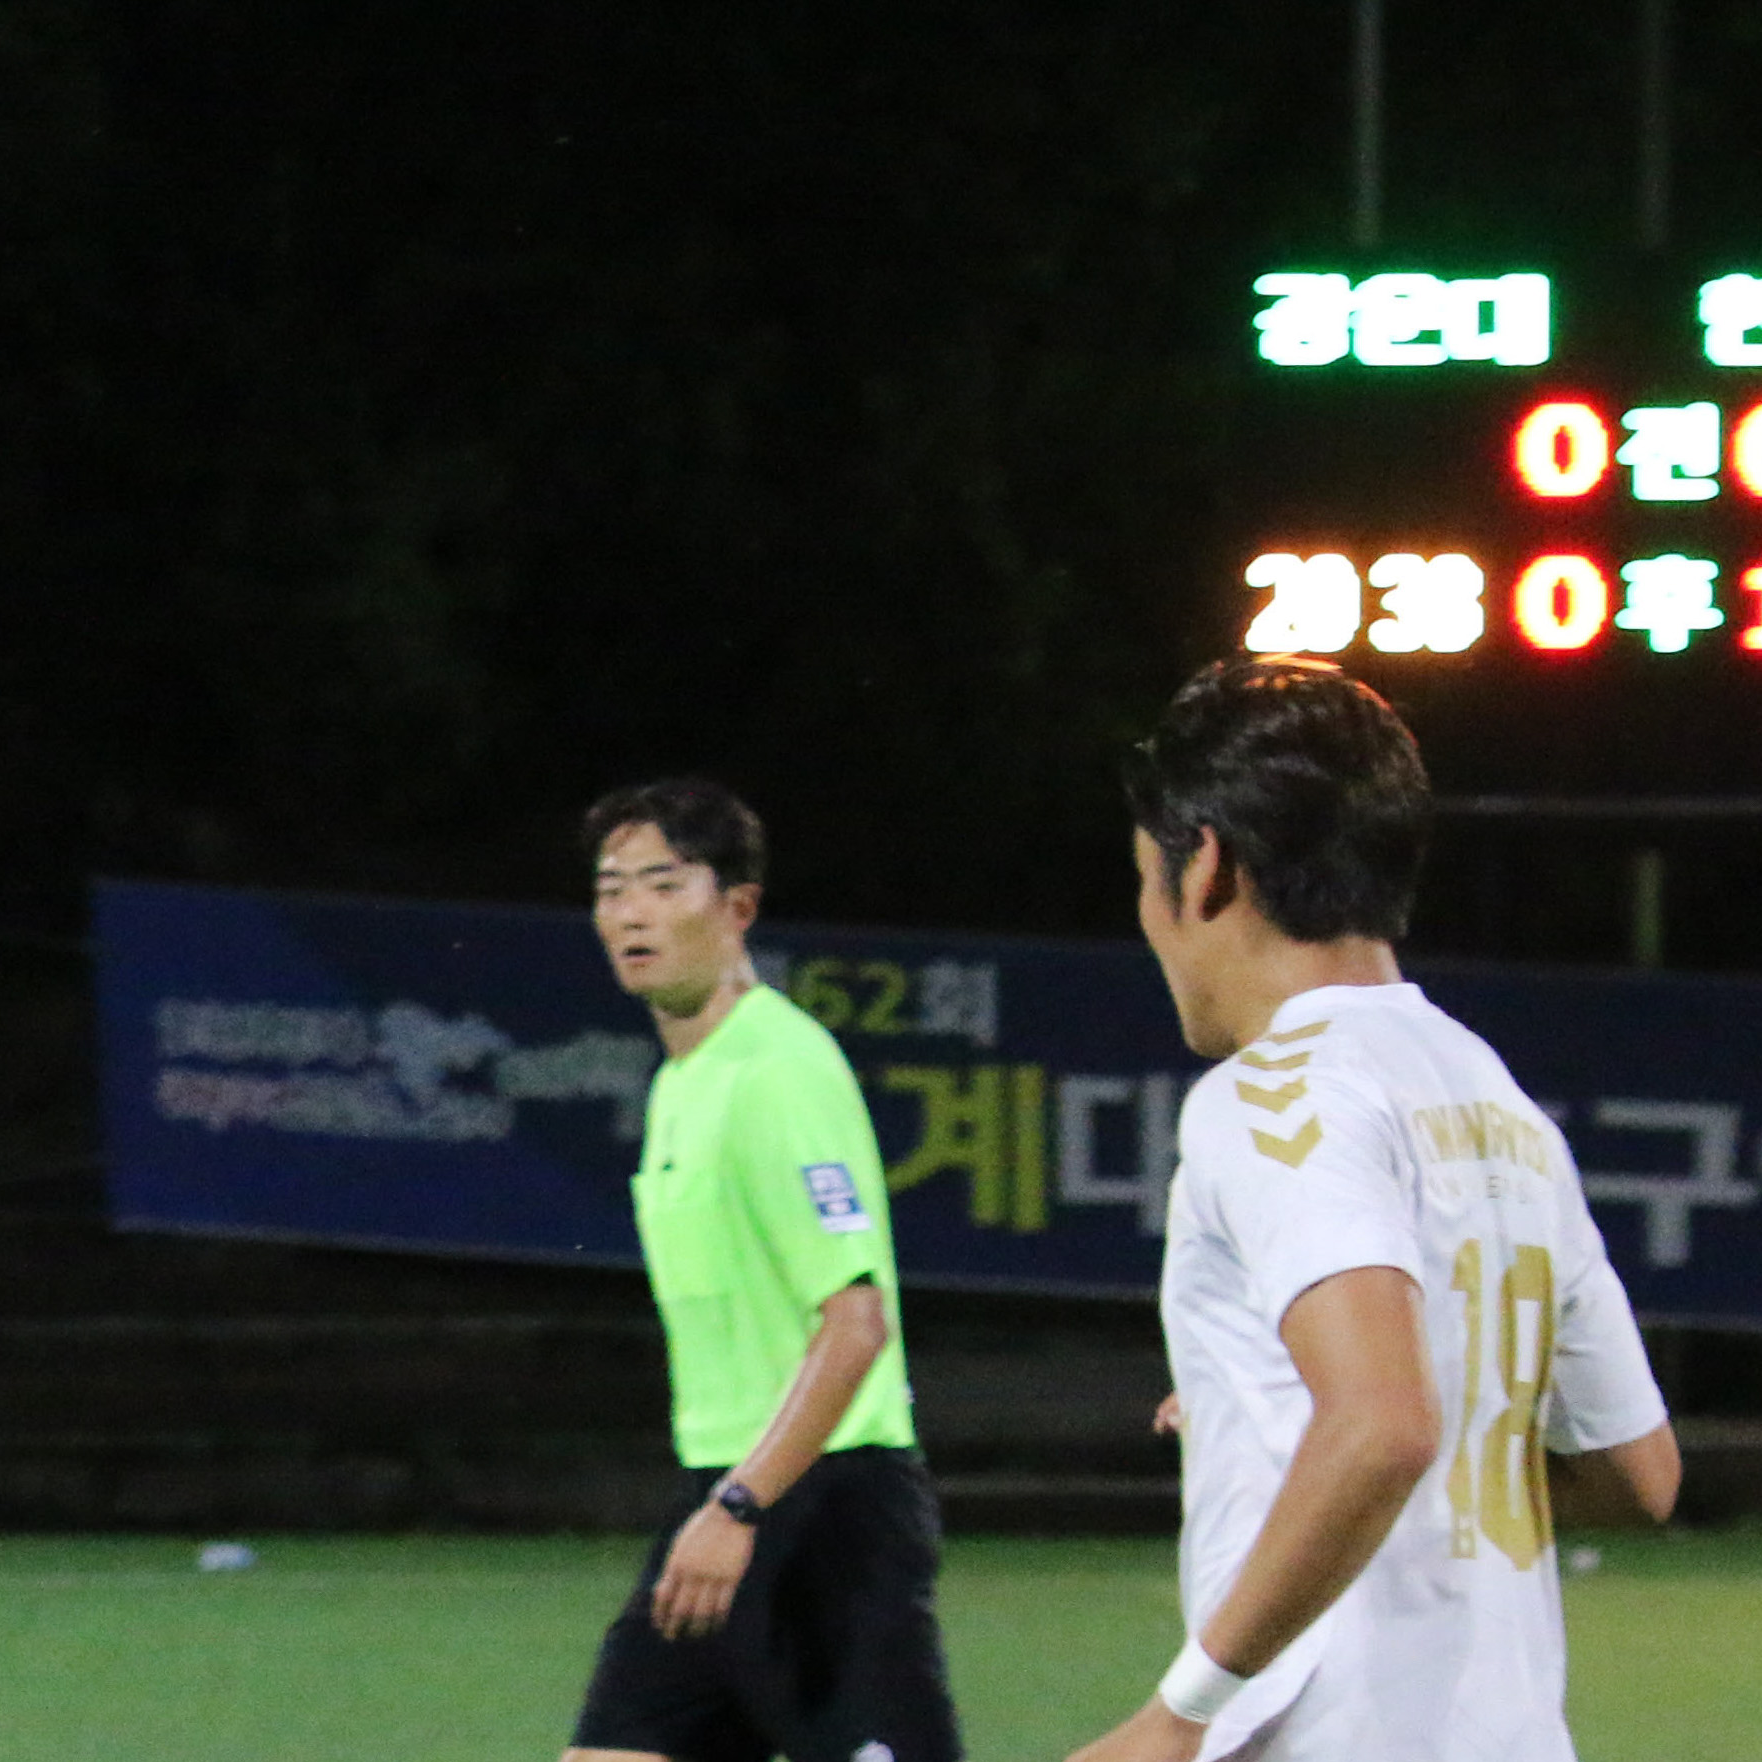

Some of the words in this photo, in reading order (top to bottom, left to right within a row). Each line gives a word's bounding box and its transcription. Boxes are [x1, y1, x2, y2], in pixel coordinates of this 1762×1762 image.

[1513, 402, 1609, 498] 0
[1616, 402, 1721, 501] 전
[1513, 555, 1607, 650] 0
[1615, 553, 1724, 653] 후
[1447, 1238, 1554, 1572] 18
